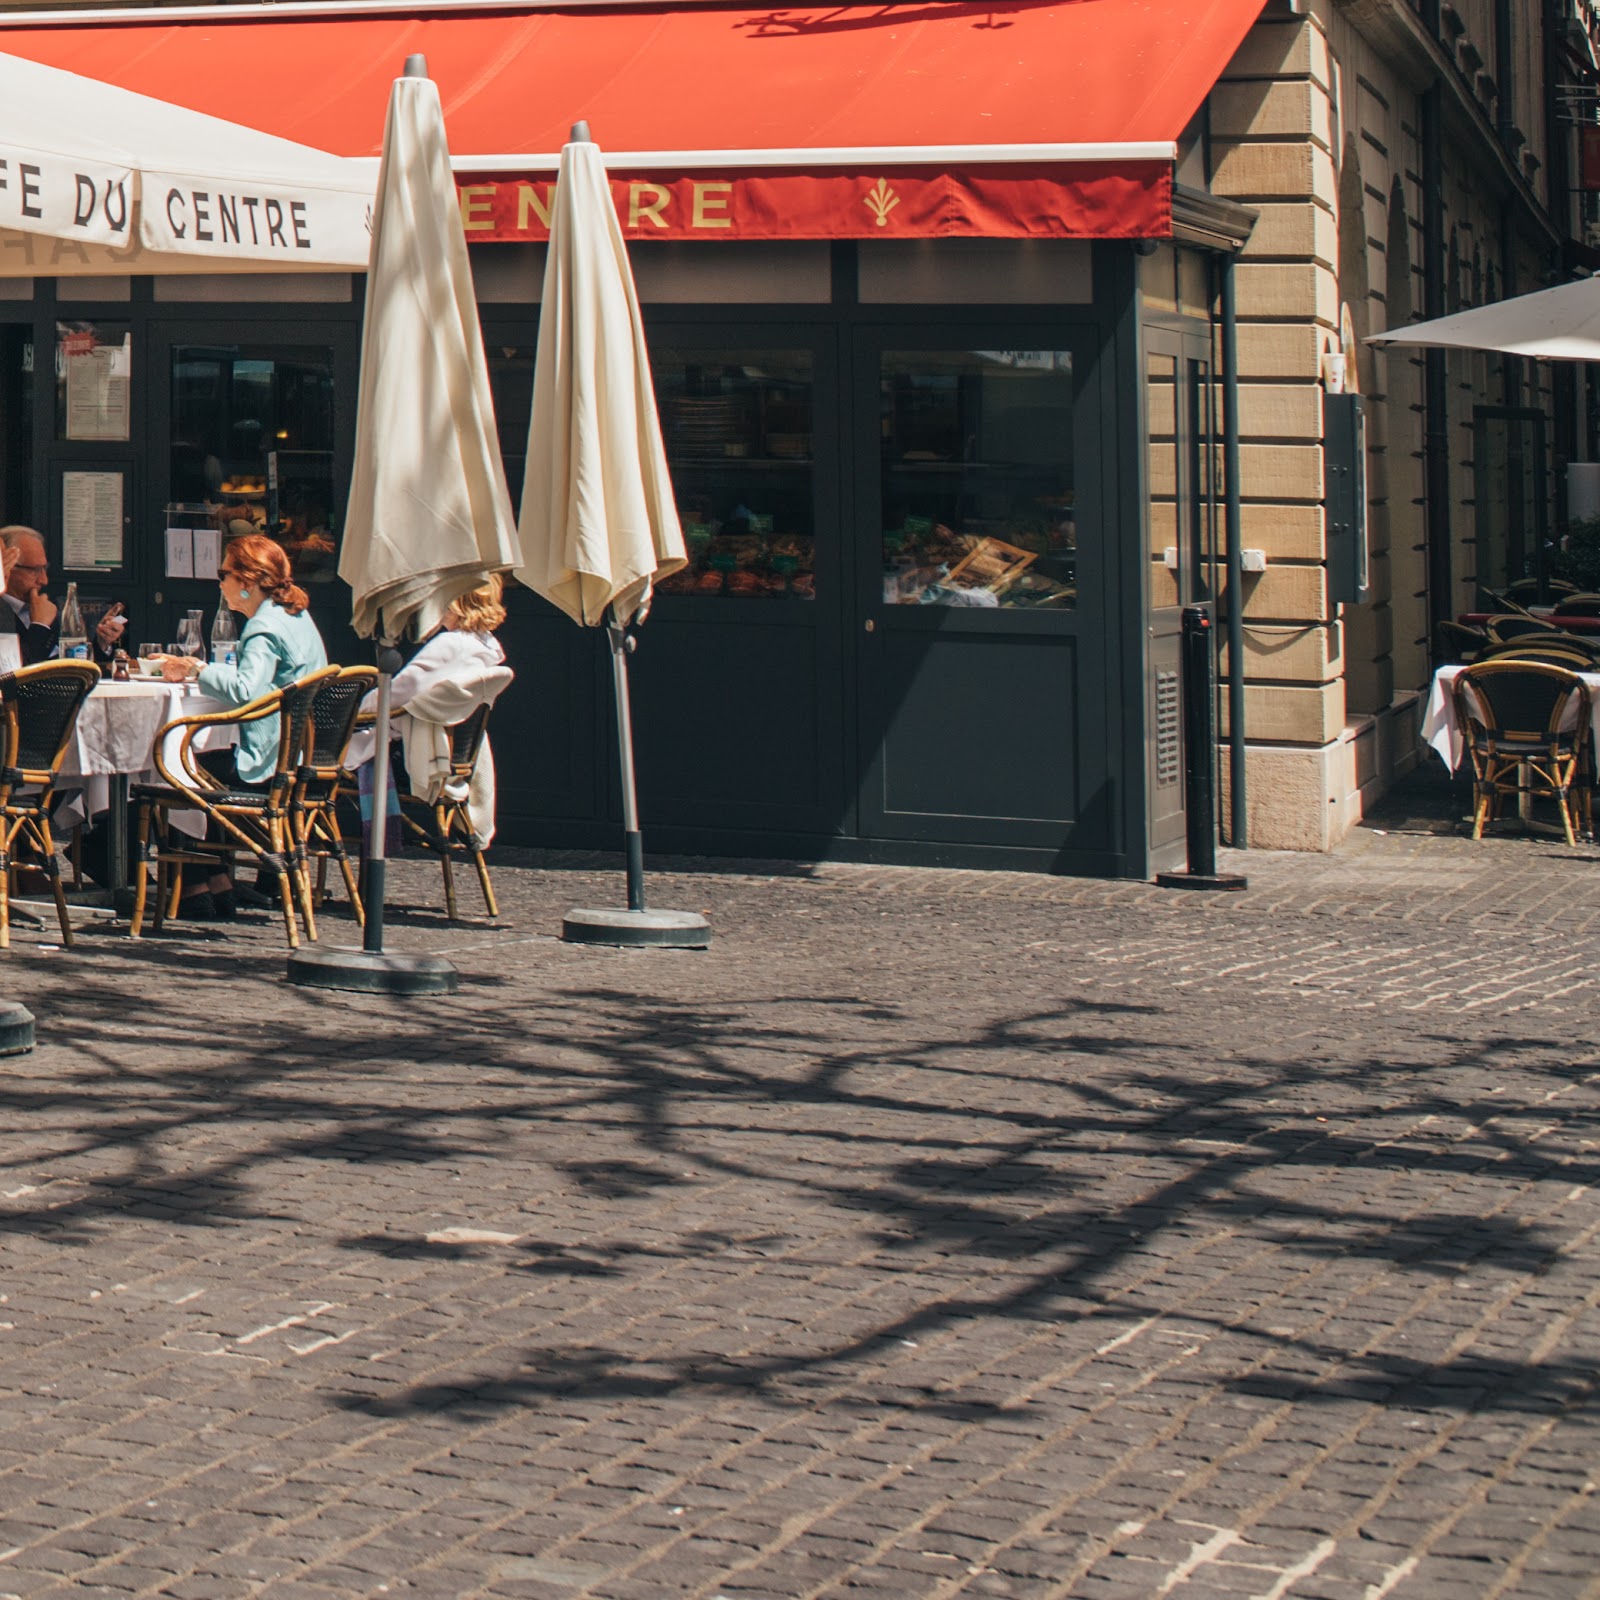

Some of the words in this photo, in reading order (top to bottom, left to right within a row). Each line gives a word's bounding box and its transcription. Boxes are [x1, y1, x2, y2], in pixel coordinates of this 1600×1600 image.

[72, 172, 129, 233] DU
[165, 188, 312, 249] CENTRE
[458, 181, 733, 232] ENRE
